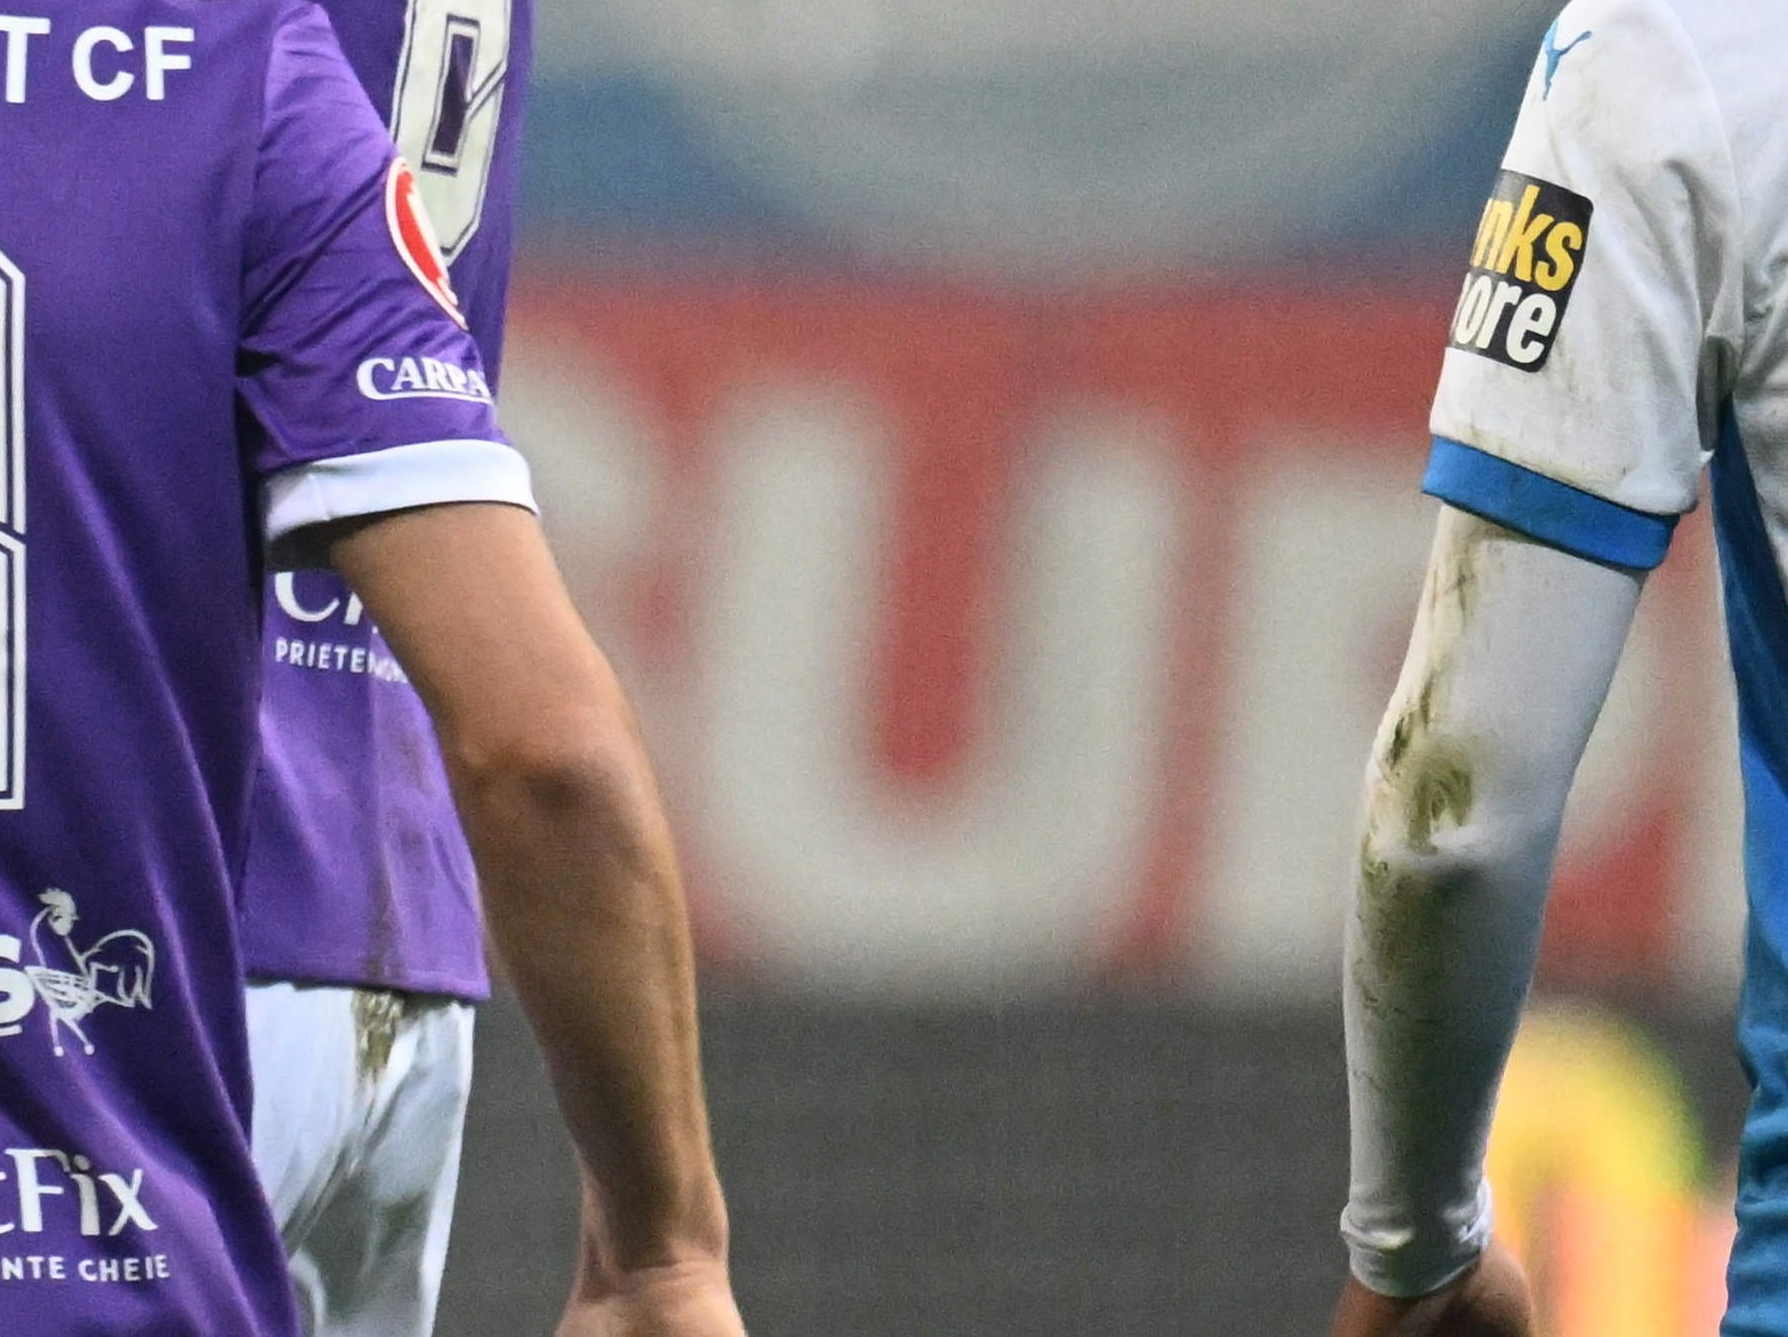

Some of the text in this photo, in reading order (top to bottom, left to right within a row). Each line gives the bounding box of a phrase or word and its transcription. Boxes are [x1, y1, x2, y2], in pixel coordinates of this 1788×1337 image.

[71, 25, 196, 102] CF
[1450, 272, 1557, 364] ore
[77, 1253, 171, 1284] CHEIE
